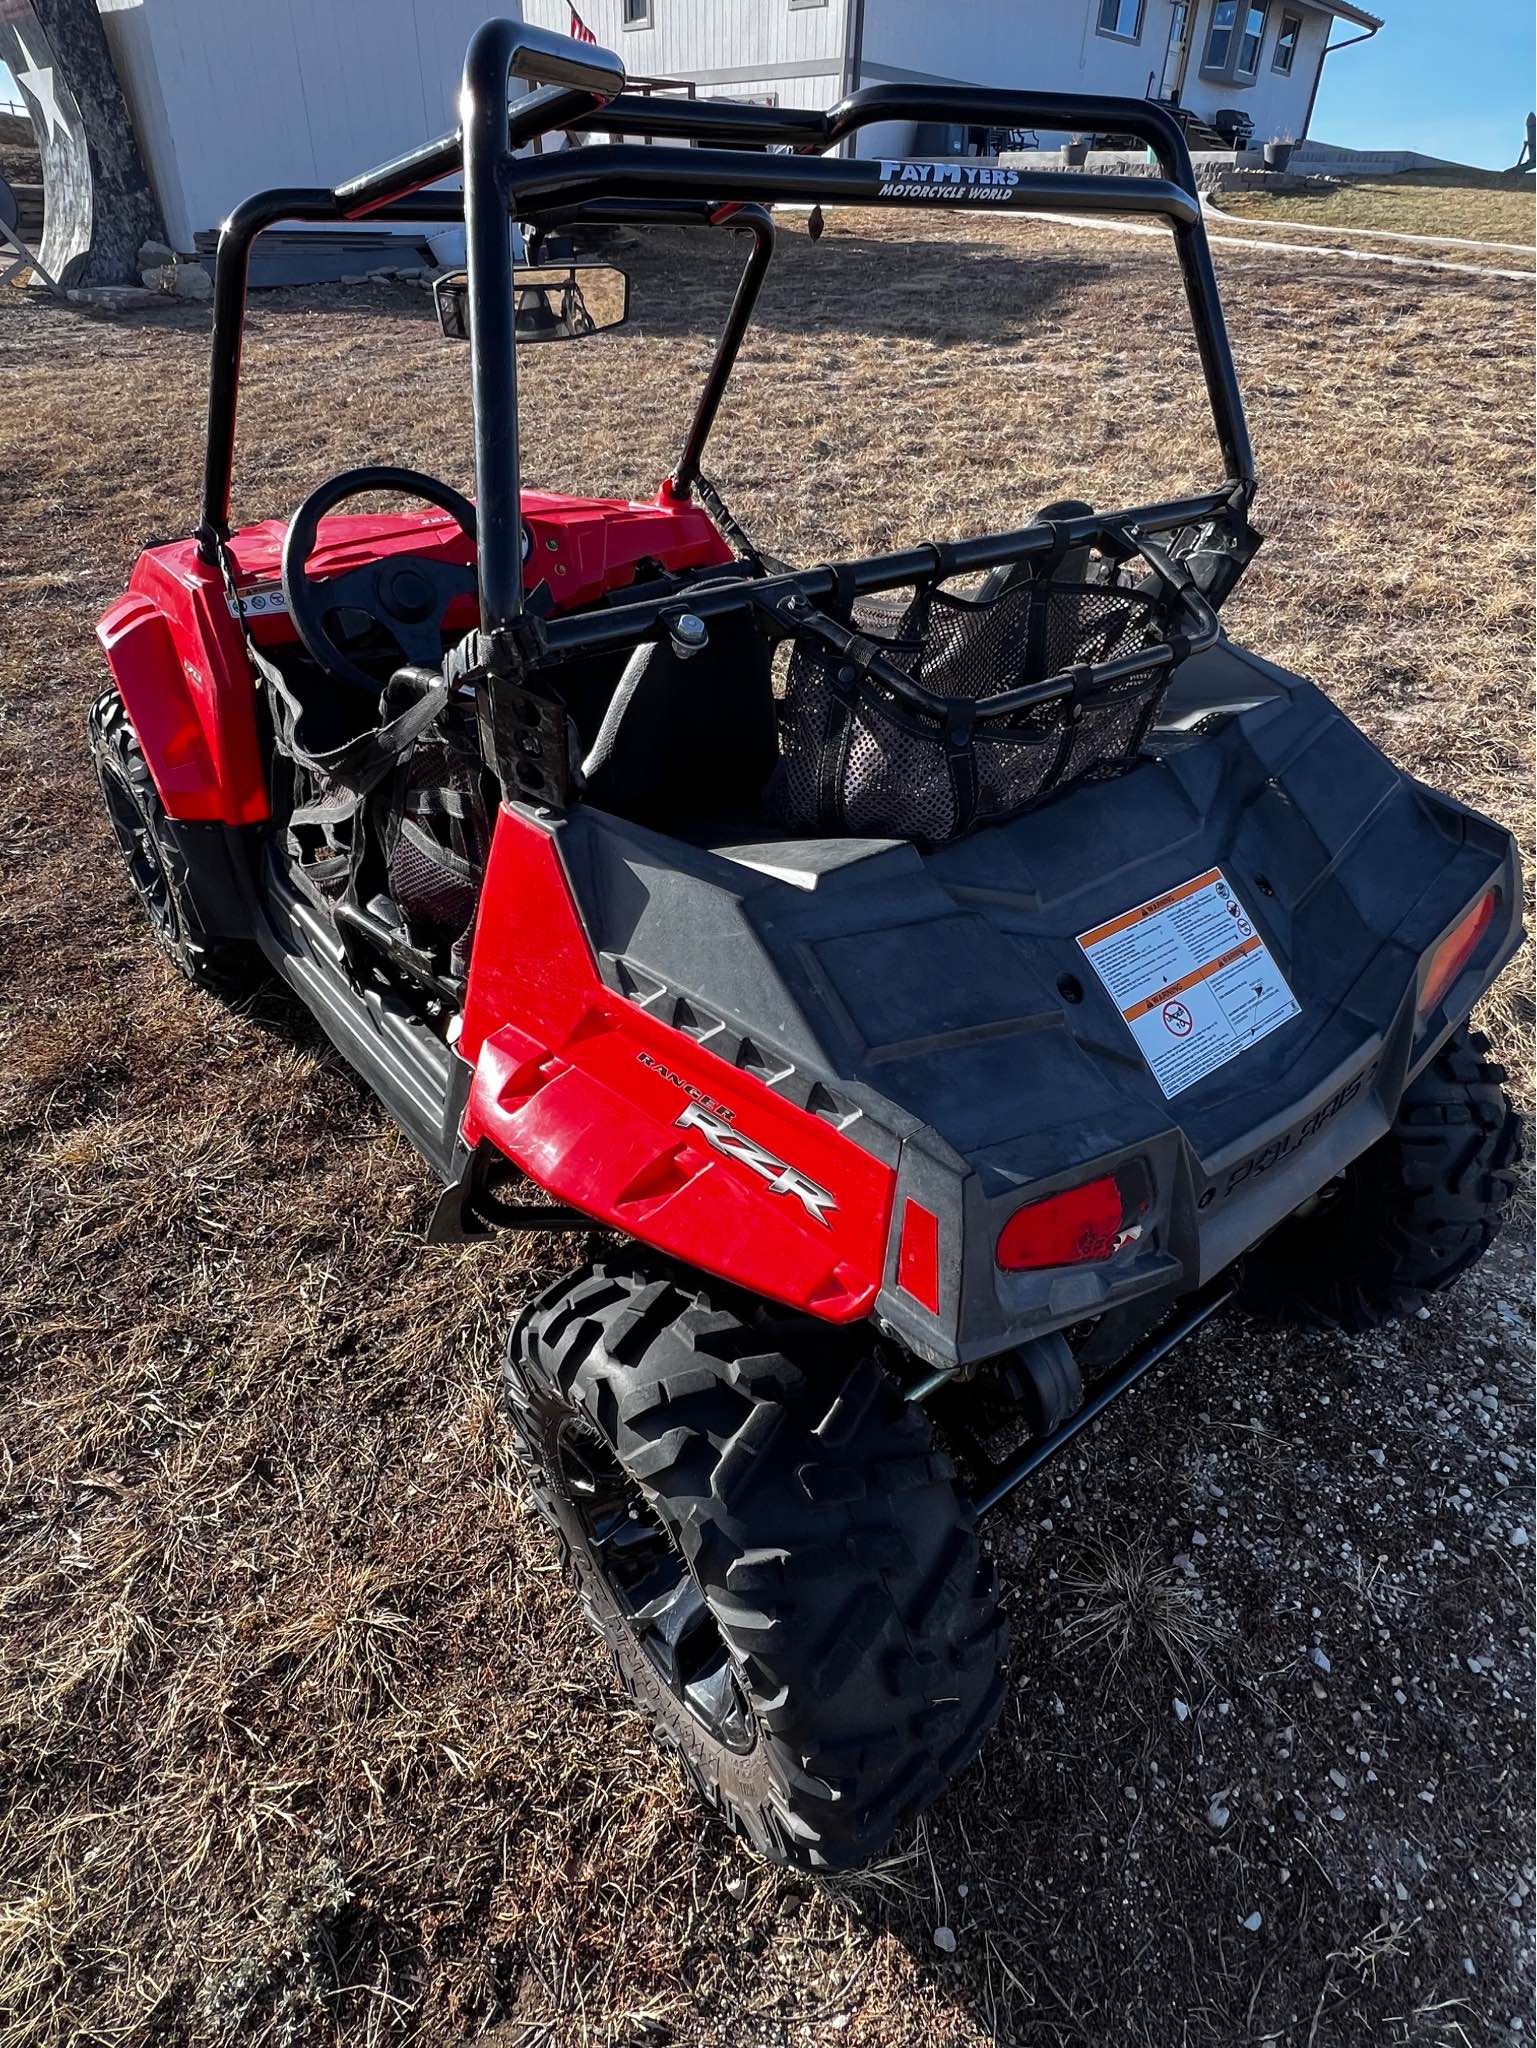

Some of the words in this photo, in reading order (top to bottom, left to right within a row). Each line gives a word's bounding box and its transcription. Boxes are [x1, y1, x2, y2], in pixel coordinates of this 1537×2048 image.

[879, 160, 931, 182] FAY
[932, 163, 1020, 186] MYERS
[878, 183, 966, 200] MOTORCYCLE
[968, 187, 1013, 201] WORLD
[1151, 982, 1183, 1003] WARNING
[636, 1051, 737, 1123] RANGER
[674, 1100, 841, 1232] RZR
